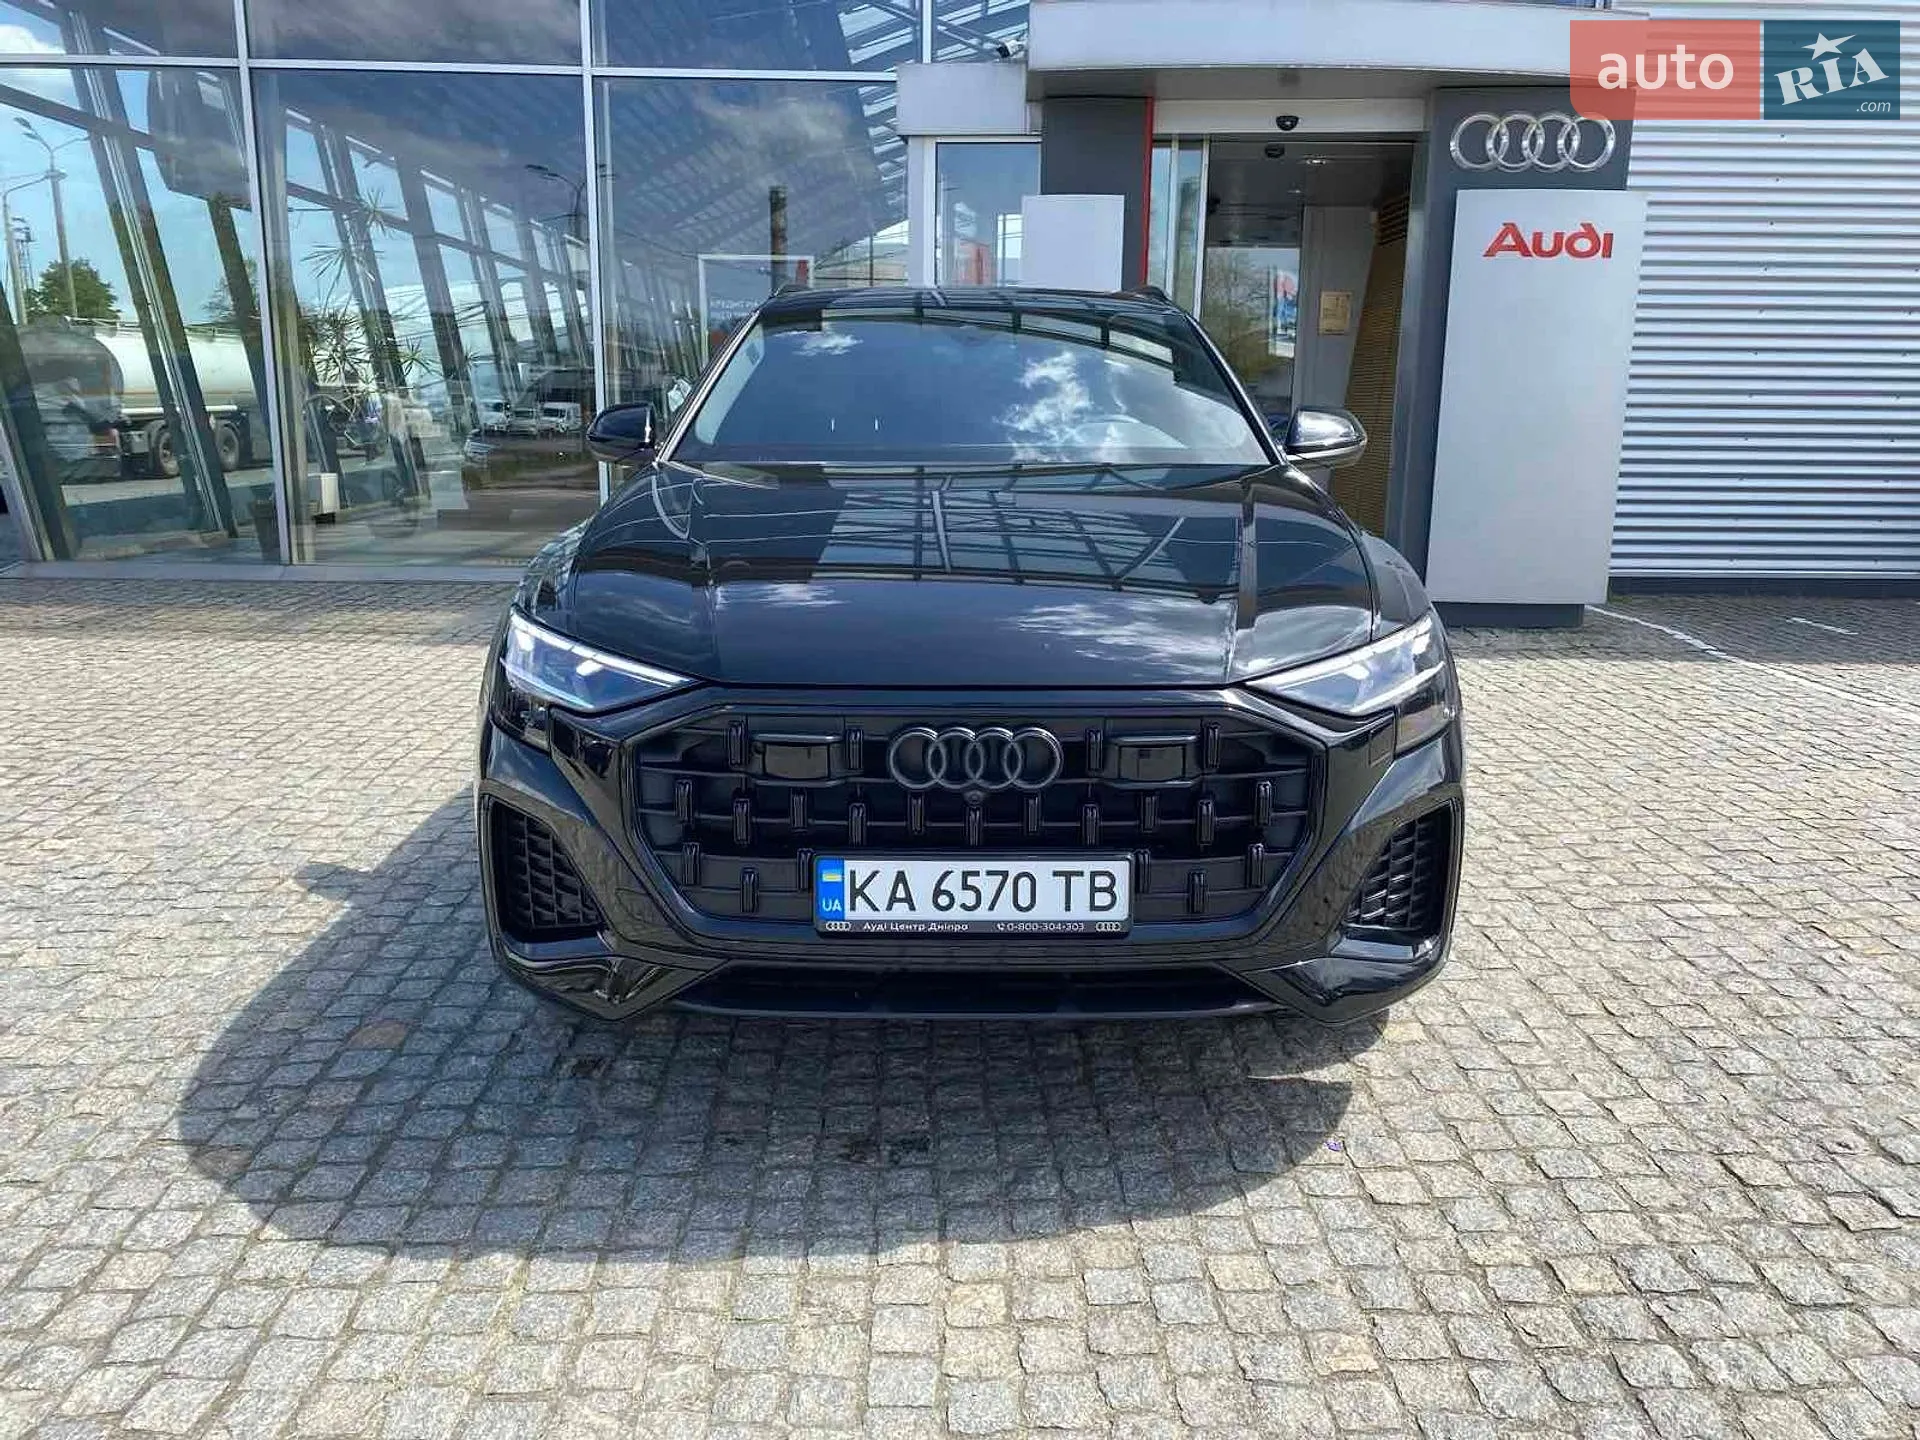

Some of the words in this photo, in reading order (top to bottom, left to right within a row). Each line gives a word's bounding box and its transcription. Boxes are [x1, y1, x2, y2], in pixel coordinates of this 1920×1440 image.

[1482, 222, 1614, 258] Audi
[850, 870, 916, 912] KA
[932, 870, 1037, 912] 6570
[1052, 870, 1118, 912] TB
[822, 898, 842, 912] UA
[863, 922, 887, 931] Ауді
[890, 922, 926, 931] Центр
[928, 922, 969, 931] Дніпро
[1006, 922, 1085, 931] 0-800-304-303
